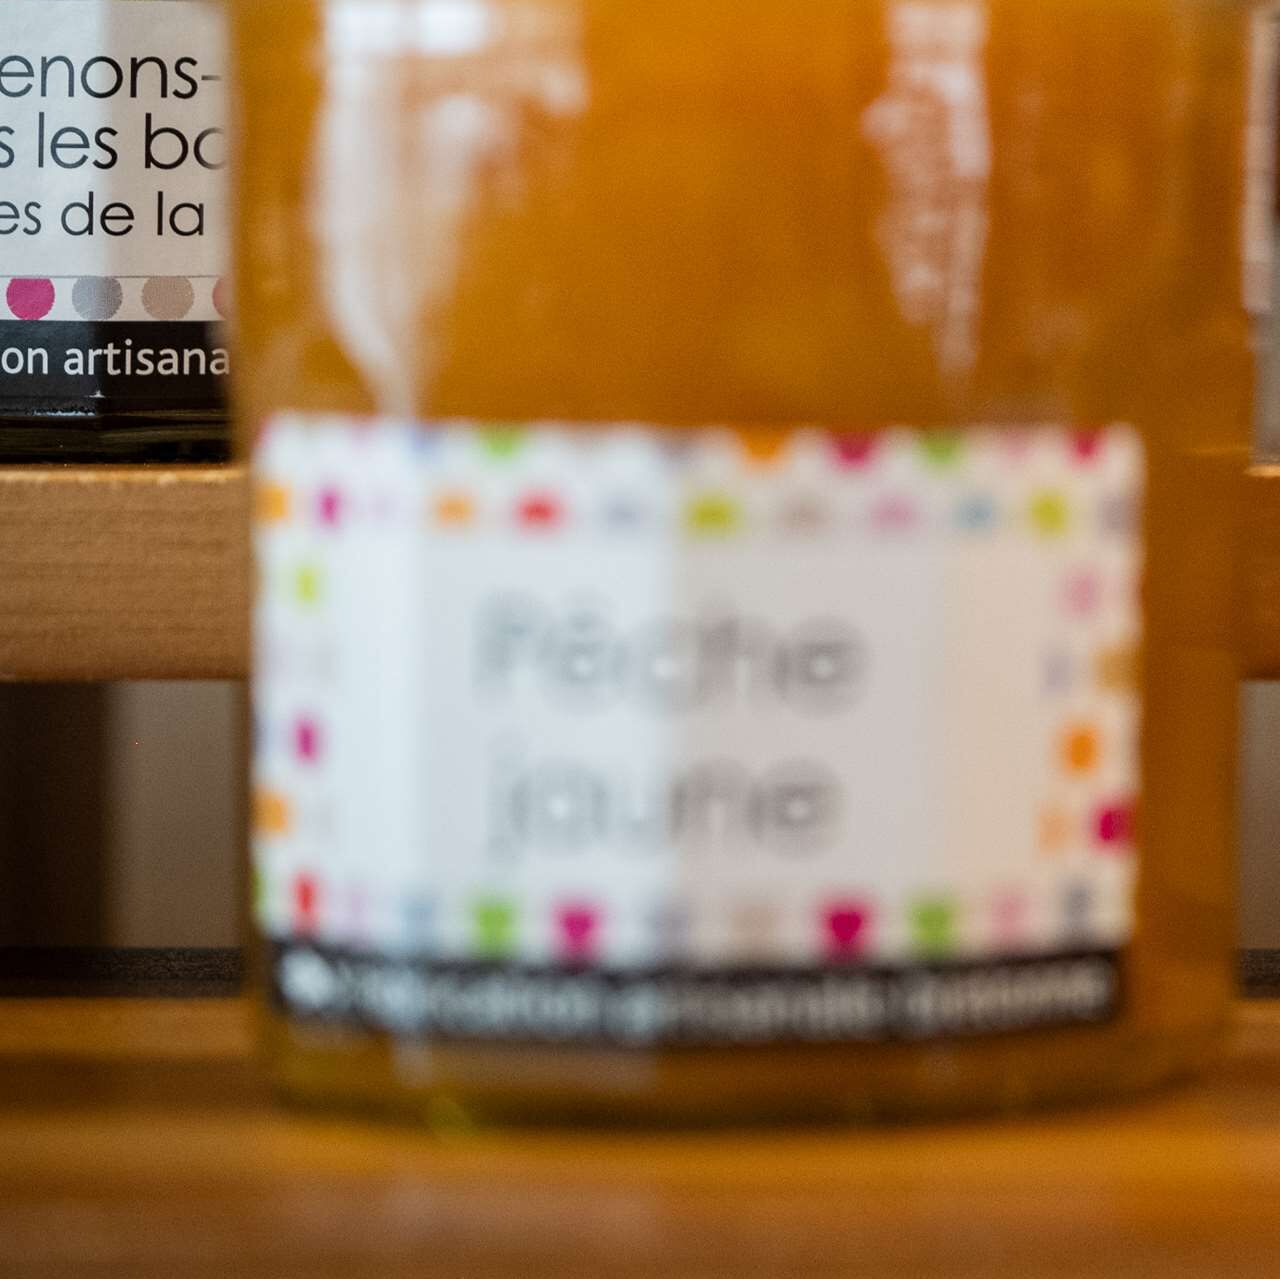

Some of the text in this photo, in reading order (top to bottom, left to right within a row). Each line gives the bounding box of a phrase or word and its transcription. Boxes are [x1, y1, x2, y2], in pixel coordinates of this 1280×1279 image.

[37, 111, 119, 170] les
[60, 190, 135, 237] de
[157, 190, 204, 237] la
